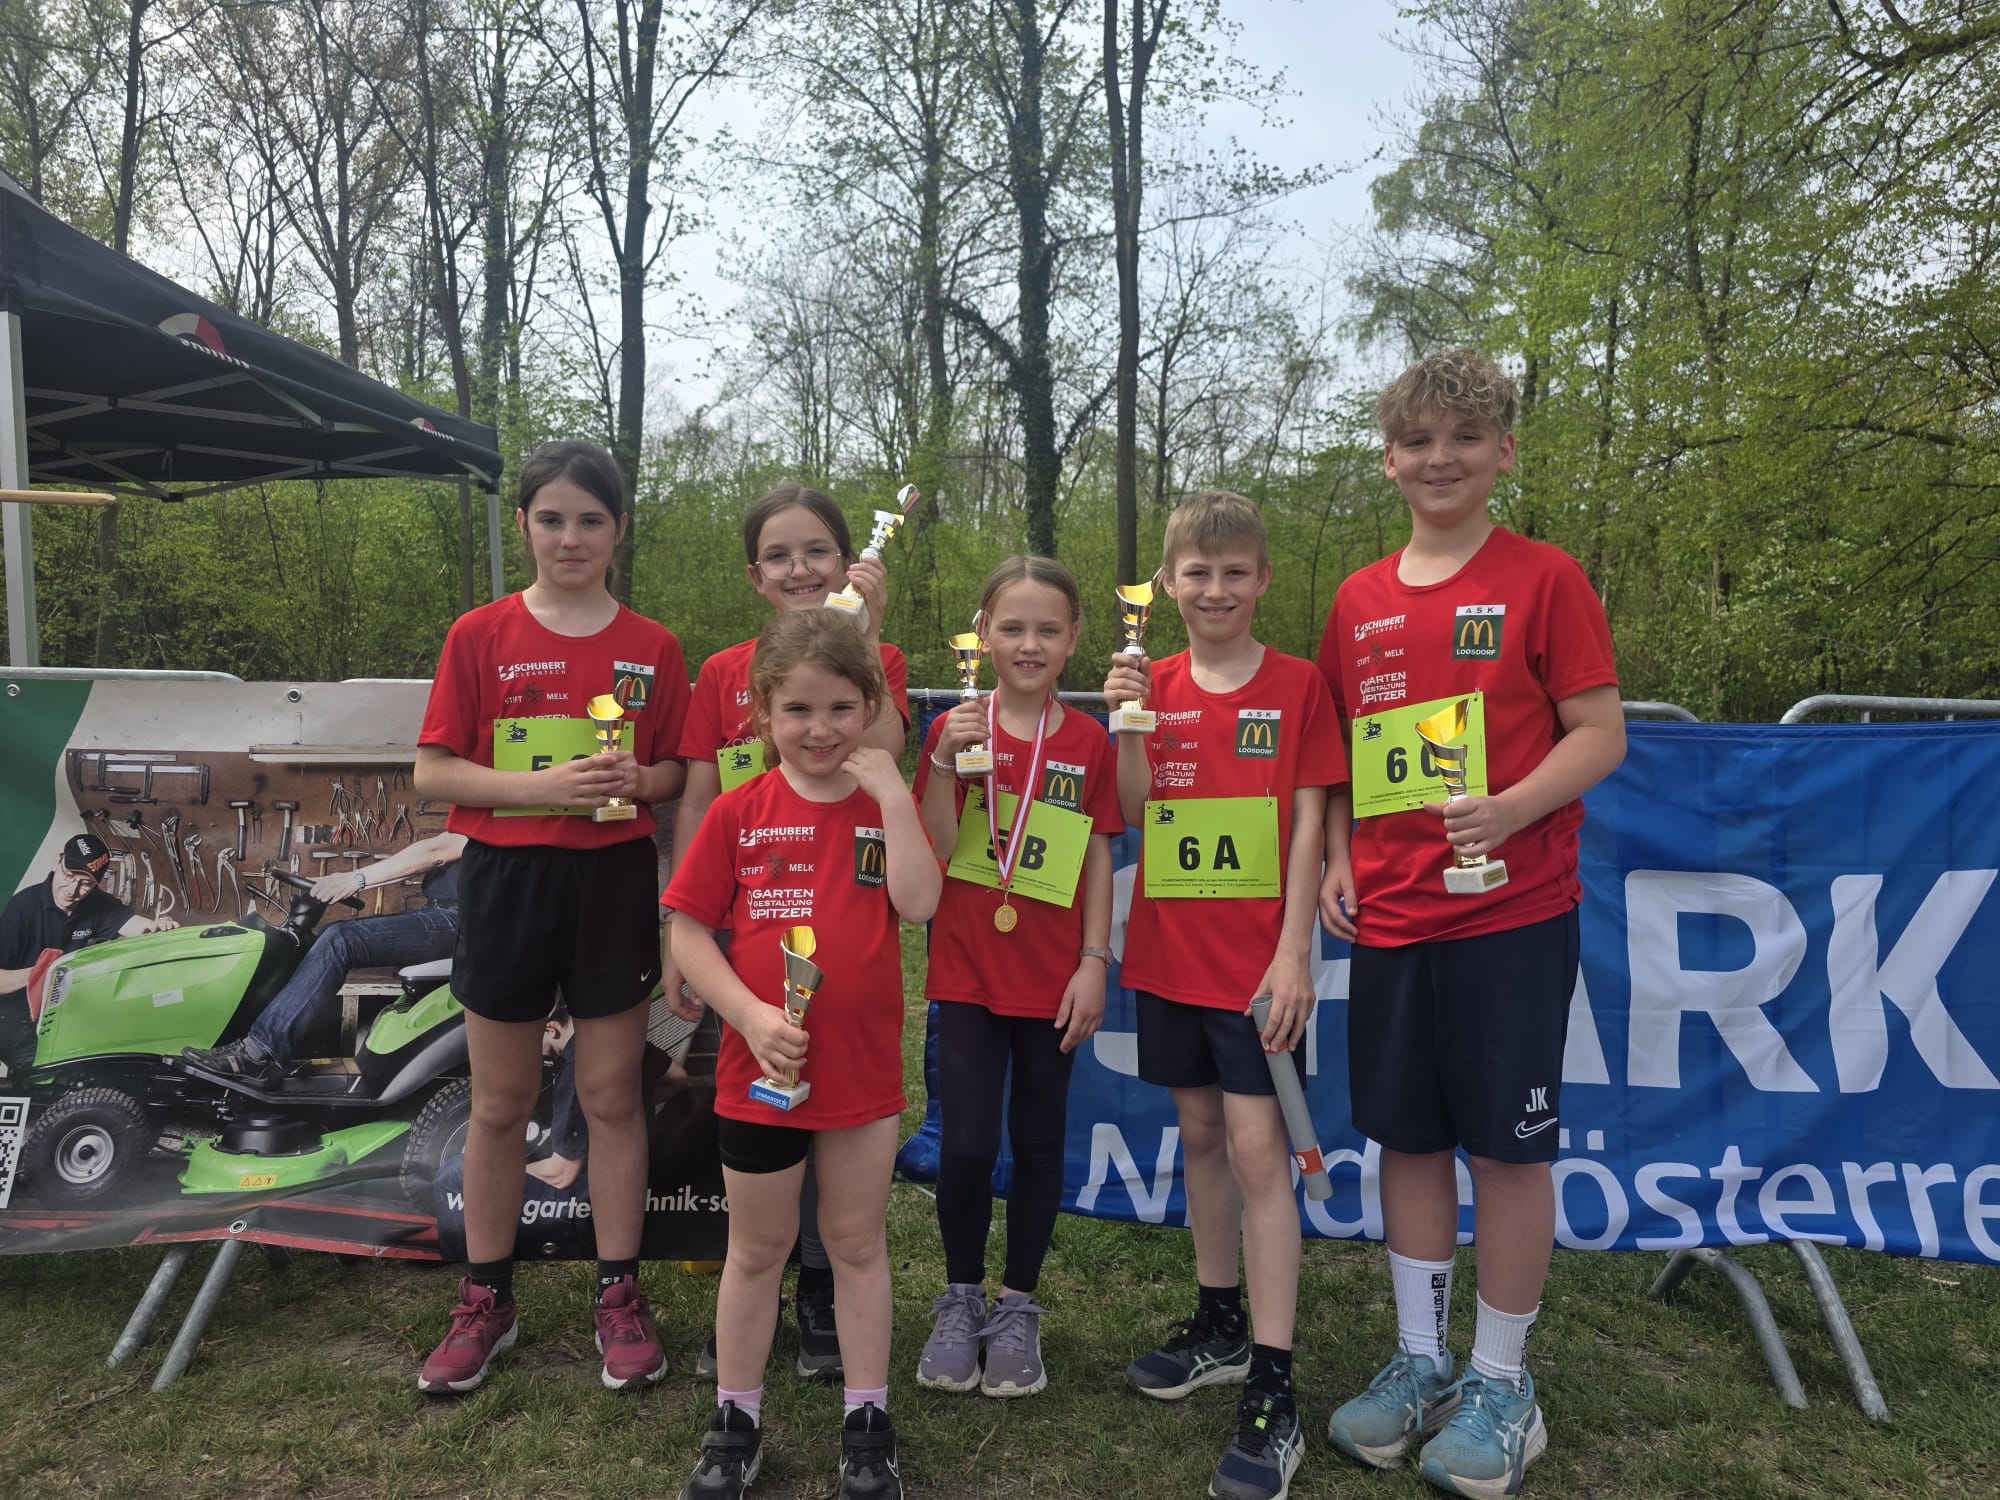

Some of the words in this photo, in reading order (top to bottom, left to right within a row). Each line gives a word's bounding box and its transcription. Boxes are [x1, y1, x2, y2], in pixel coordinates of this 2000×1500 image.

[1364, 615, 1406, 632] SCHUBERT
[1384, 648, 1405, 658] MELK
[514, 661, 567, 672] SCHUBERT
[546, 692, 569, 701] MELK
[1159, 710, 1203, 721] SCHUBERT
[1180, 742, 1199, 750] MELK
[1386, 746, 1409, 784] 6
[756, 826, 816, 838] SCHUBERT
[756, 835, 814, 845] CLEANTECH
[1019, 834, 1047, 871] B
[1178, 836, 1201, 871] 6
[1213, 834, 1241, 871] A
[741, 865, 765, 876] STIFT
[788, 863, 815, 872] MELK
[752, 888, 814, 899] GARTEN
[752, 899, 813, 907] GESTALTUNG
[750, 907, 813, 920] SPITZER
[1525, 1086, 1549, 1113] JK
